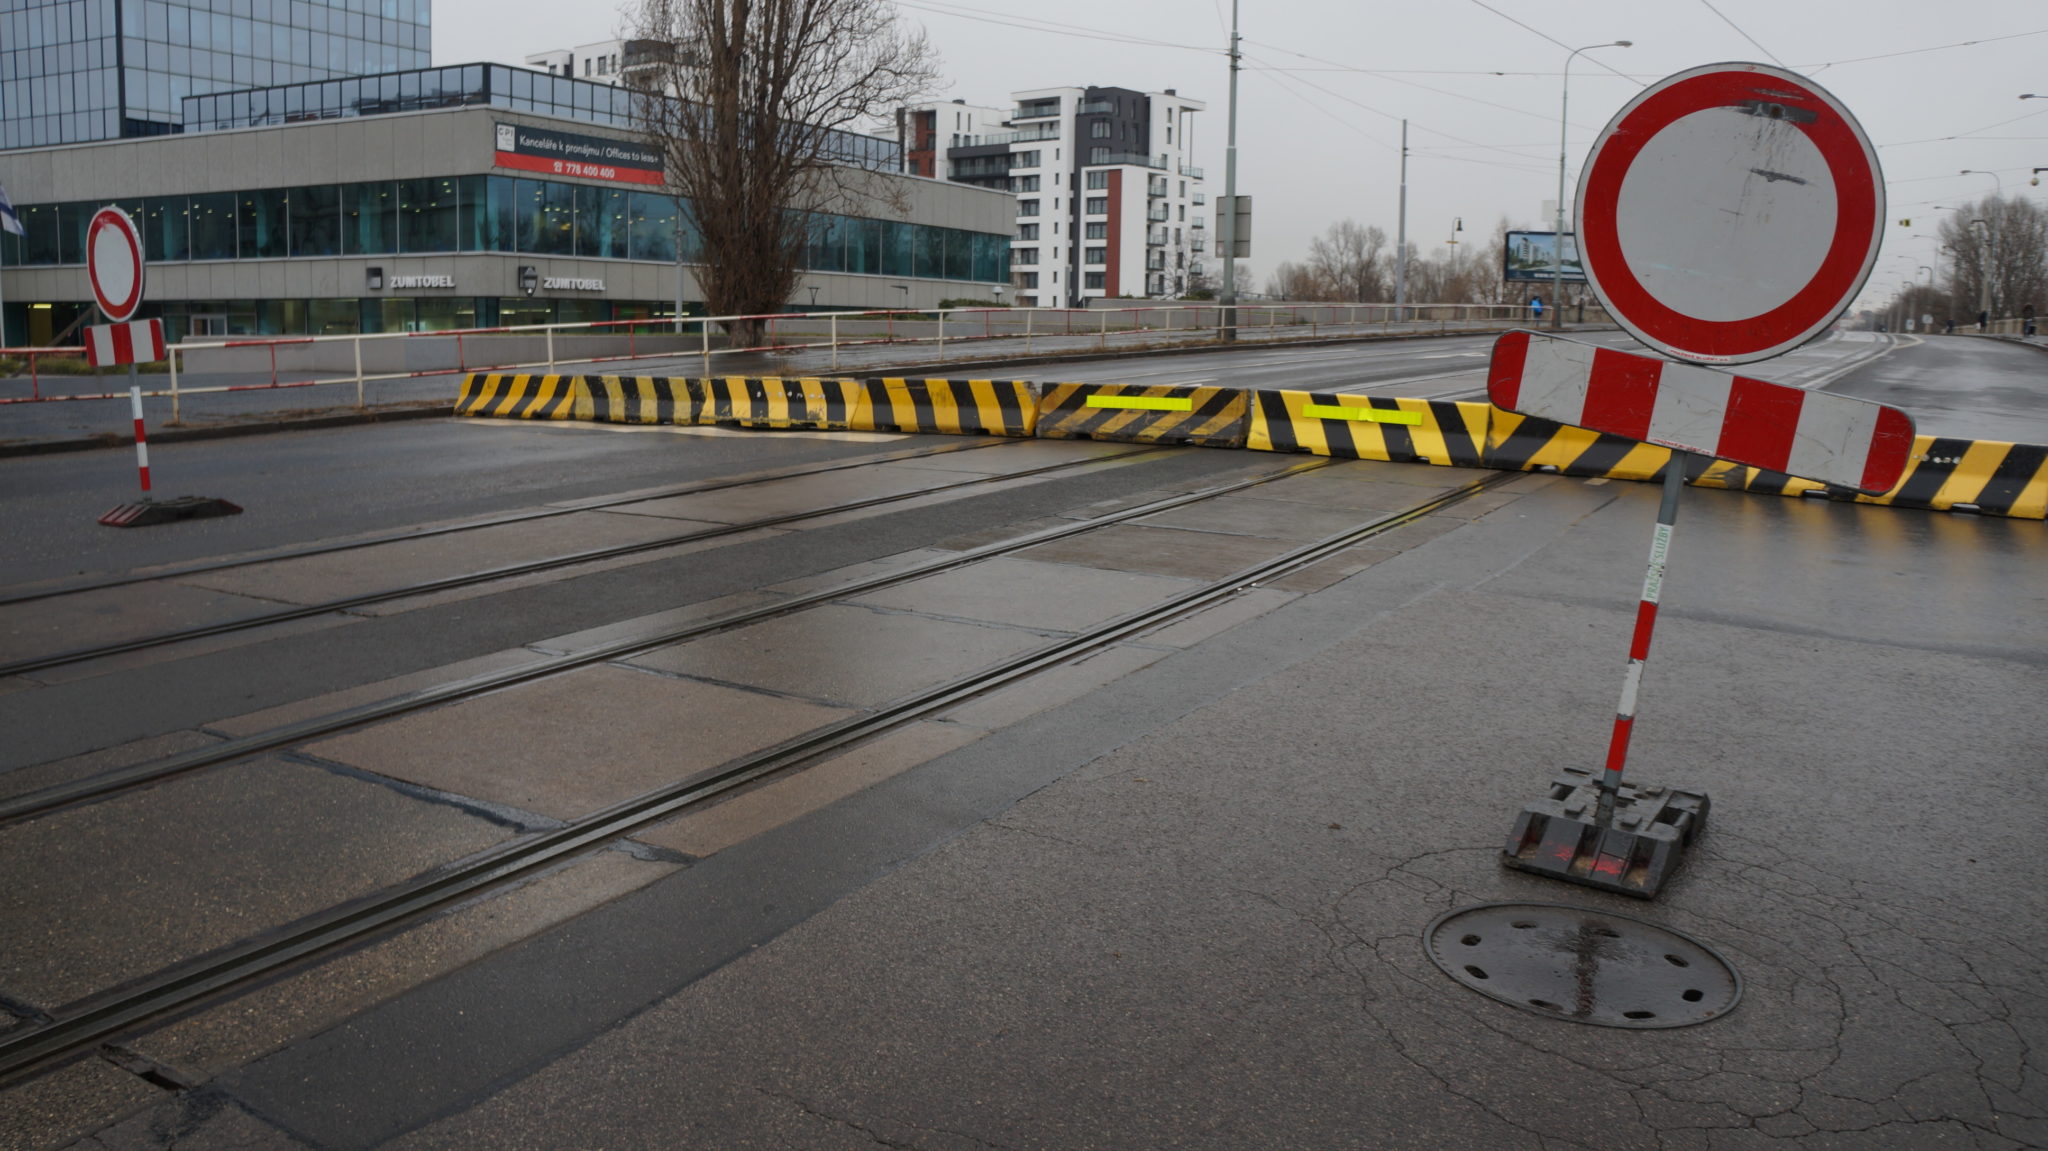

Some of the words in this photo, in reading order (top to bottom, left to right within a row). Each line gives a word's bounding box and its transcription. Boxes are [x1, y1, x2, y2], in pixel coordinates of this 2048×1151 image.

[519, 135, 557, 150] Kanceláře
[565, 144, 600, 157] pronájmu
[606, 147, 631, 160] Offices
[631, 152, 640, 160] to
[566, 163, 581, 175] 778
[583, 165, 598, 177] 400
[600, 167, 615, 179] 400
[390, 275, 456, 289] ZUMTOBEL
[543, 277, 606, 291] ZUMTOBEL
